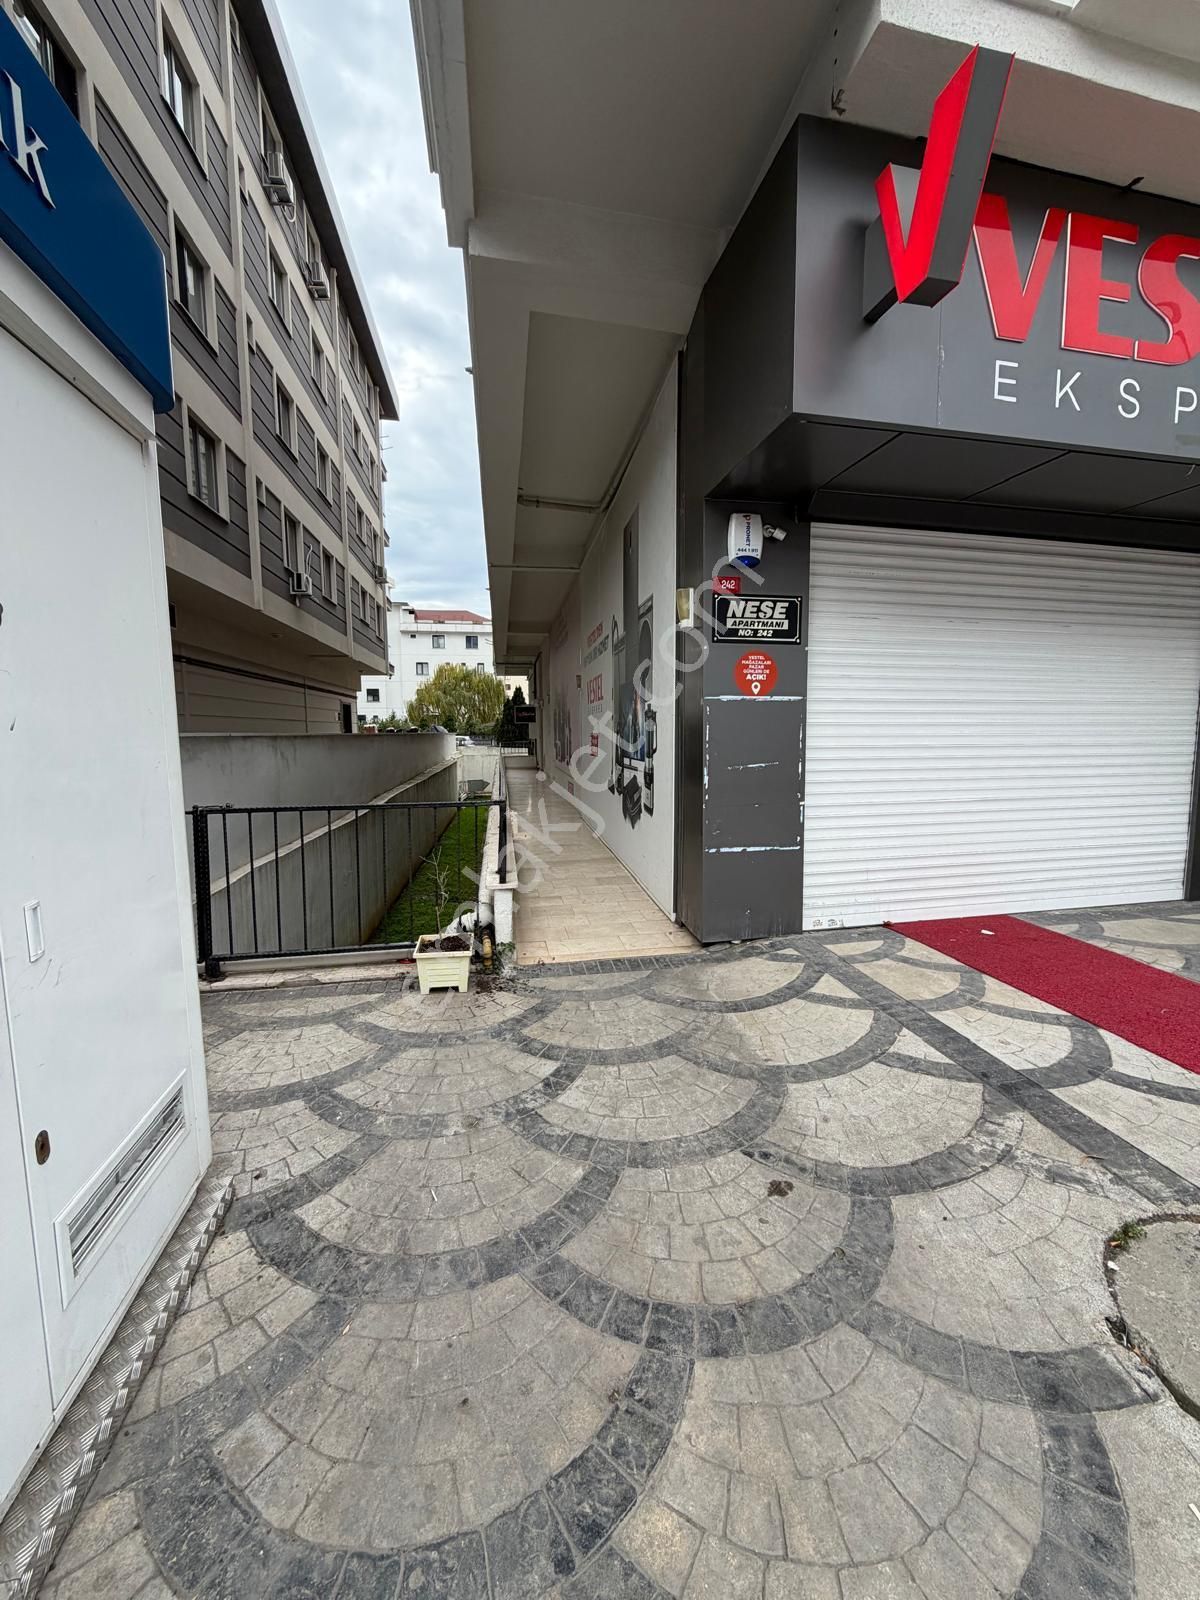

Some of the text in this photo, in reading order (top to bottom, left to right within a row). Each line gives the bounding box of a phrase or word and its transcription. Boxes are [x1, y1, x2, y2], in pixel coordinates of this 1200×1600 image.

[993, 360, 1198, 424] EKSP
[721, 580, 735, 589] 242
[731, 620, 784, 628] APARTMANI
[738, 629, 773, 637] NO: 242
